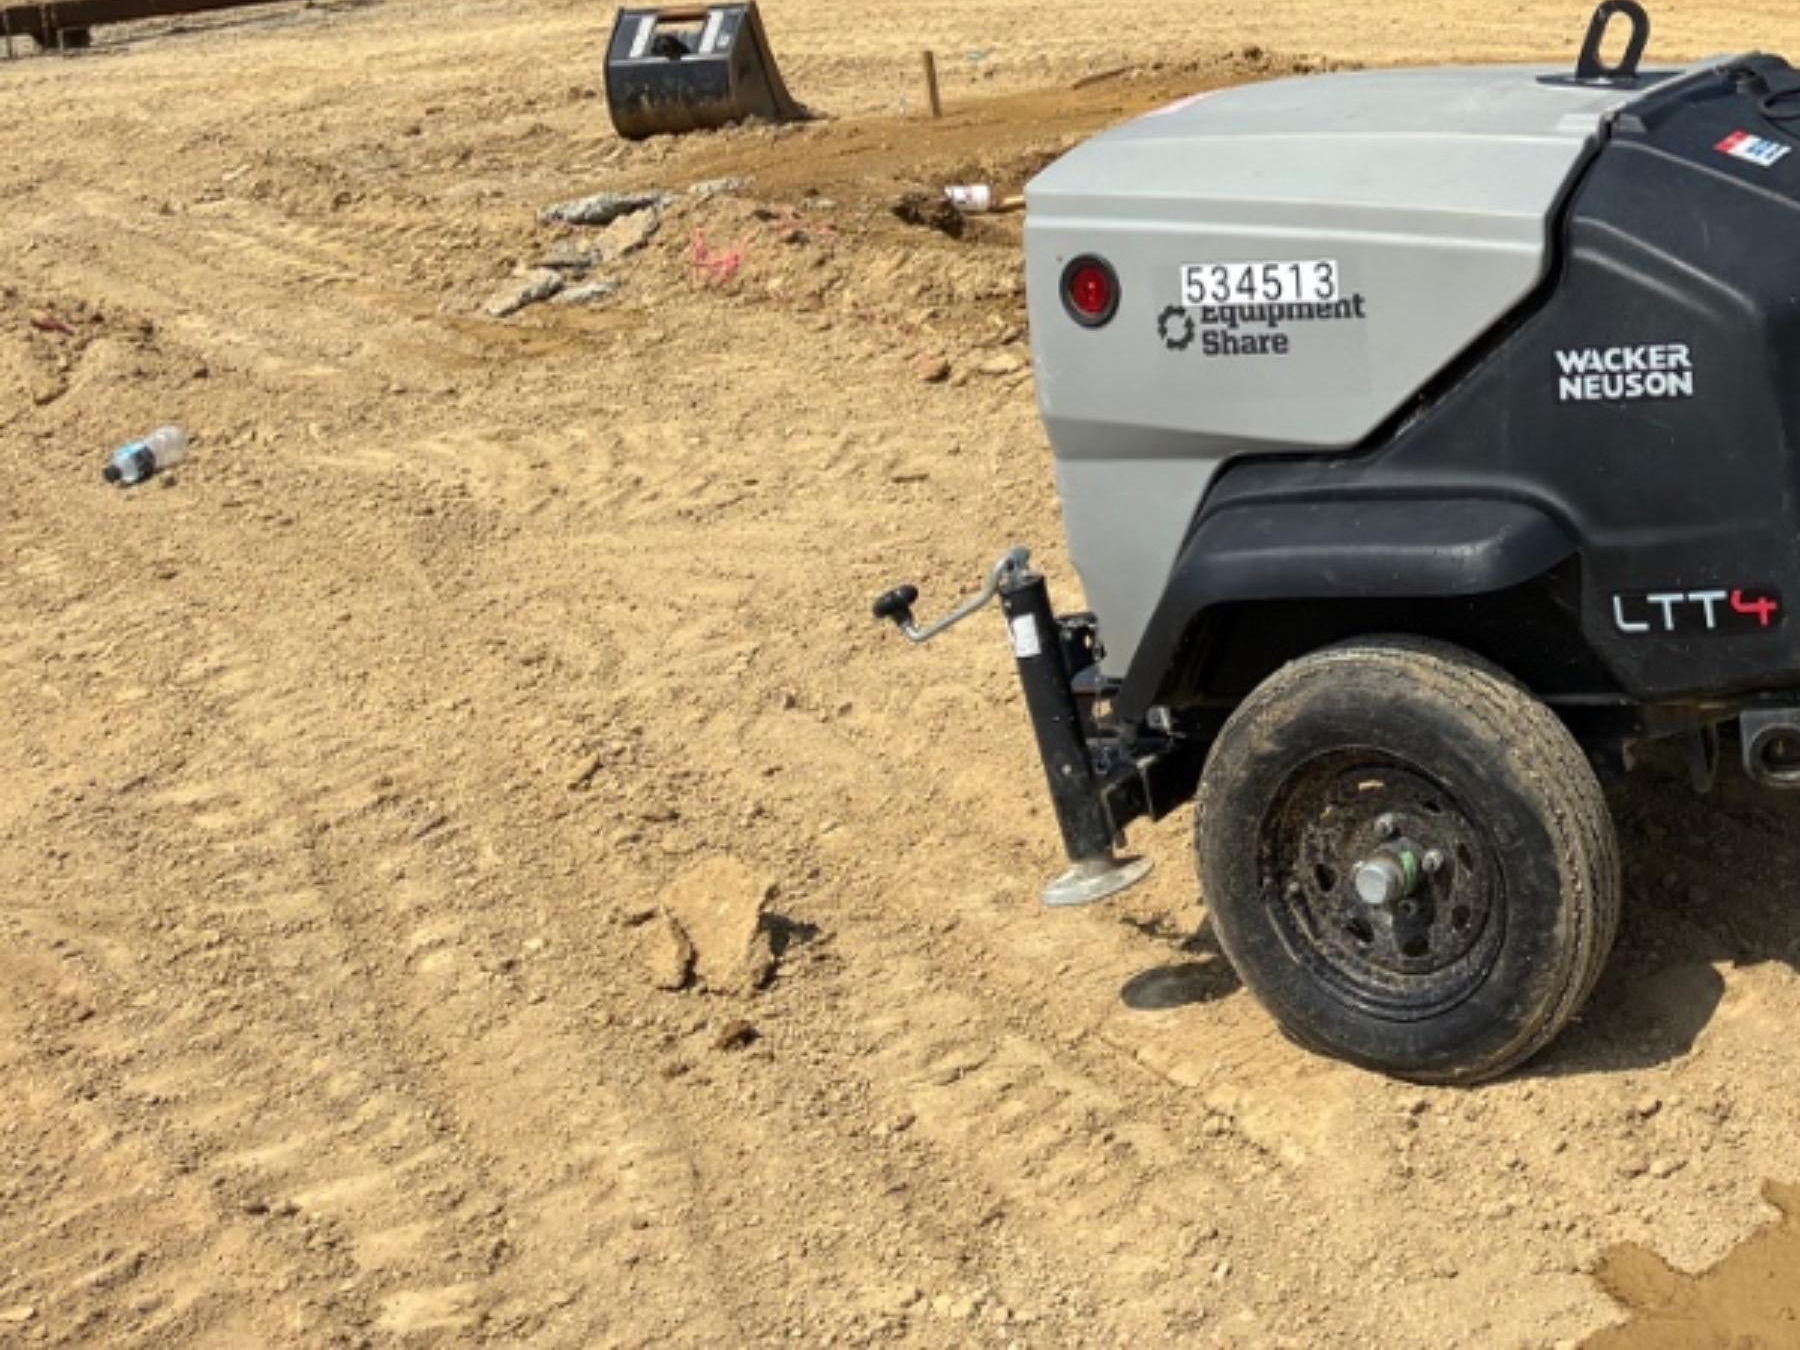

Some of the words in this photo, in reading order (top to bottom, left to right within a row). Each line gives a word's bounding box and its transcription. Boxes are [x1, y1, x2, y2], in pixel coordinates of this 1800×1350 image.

[1186, 262, 1334, 302] 534513
[1201, 293, 1366, 328] Equipment
[1202, 329, 1289, 355] Share
[1554, 344, 1692, 374] WACKER
[1559, 370, 1693, 401] NEUSON
[1612, 589, 1777, 631] LTT4
